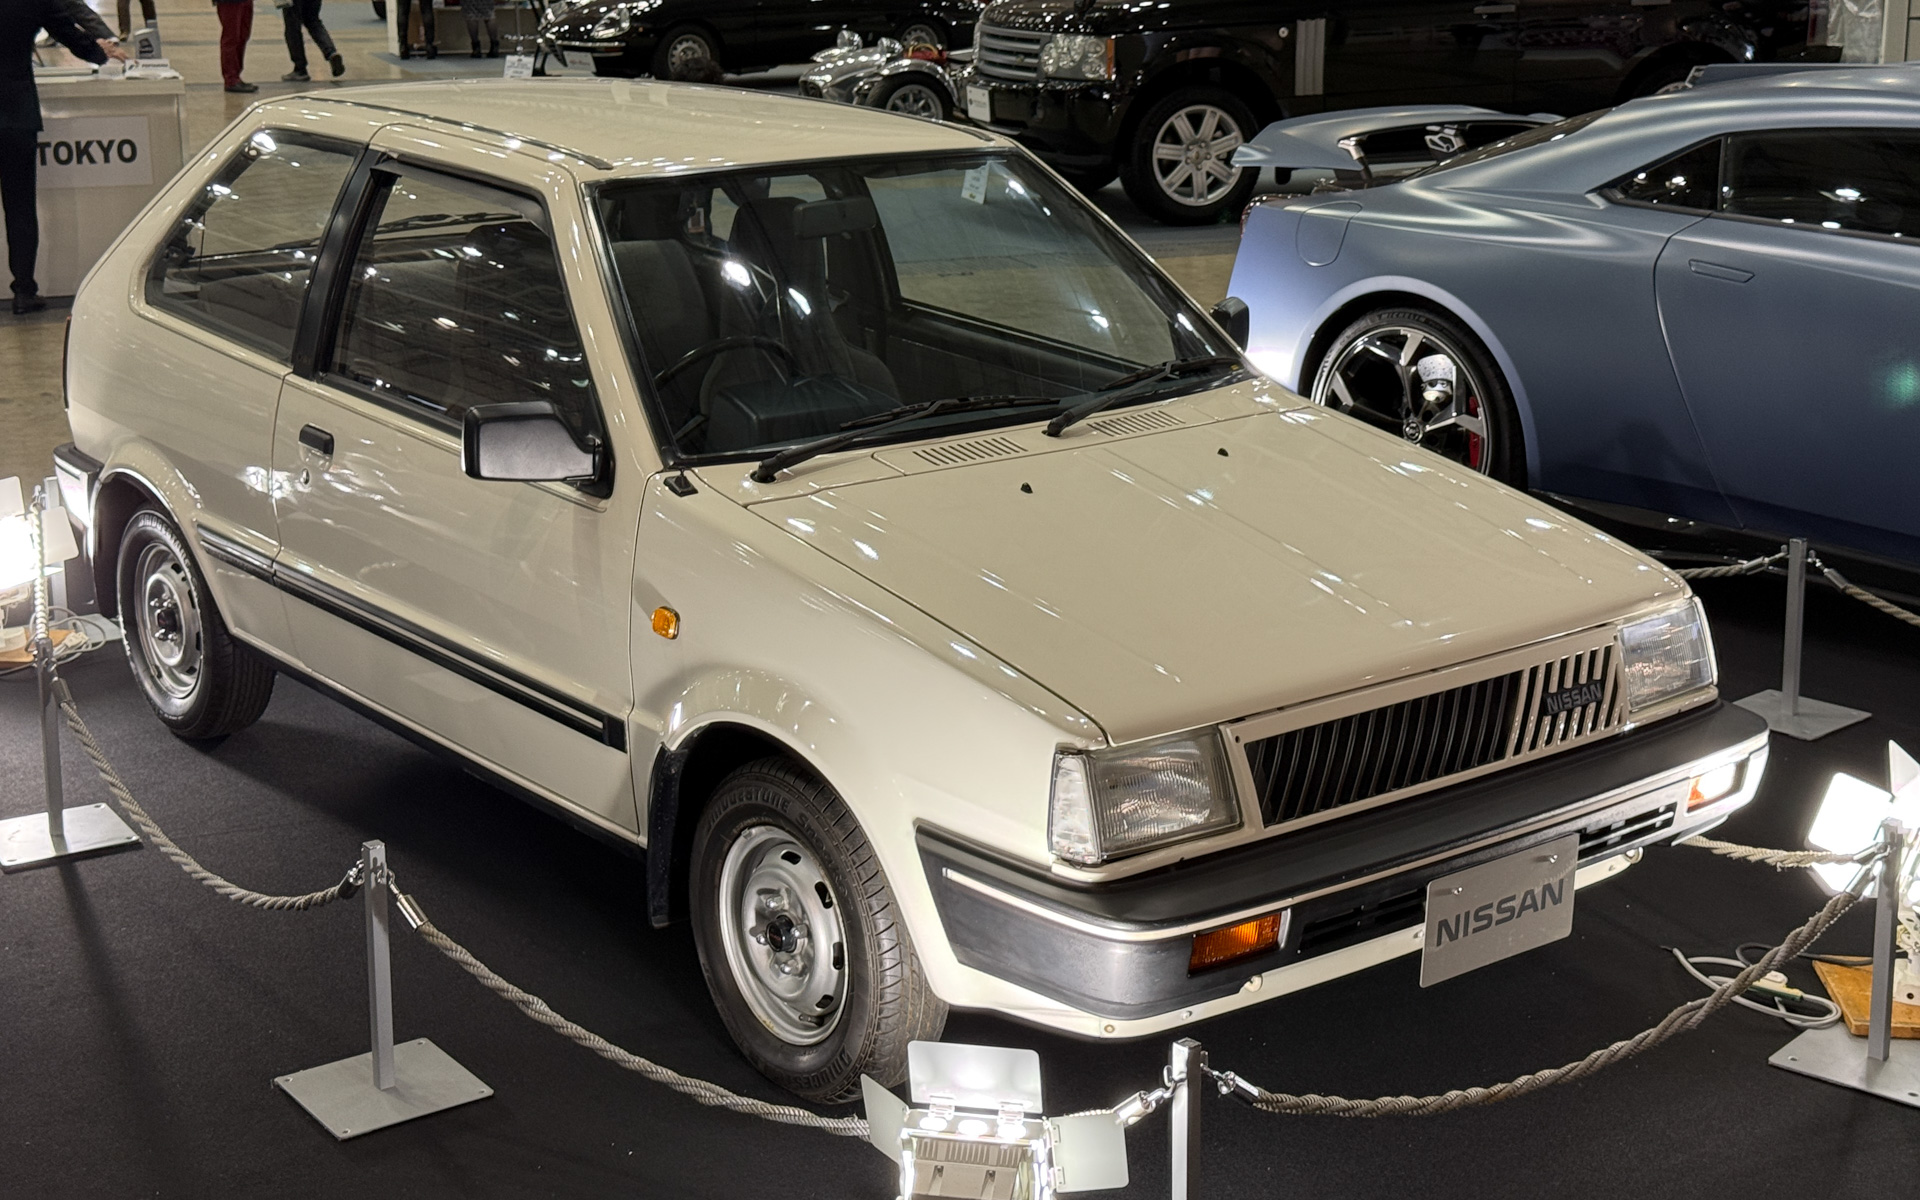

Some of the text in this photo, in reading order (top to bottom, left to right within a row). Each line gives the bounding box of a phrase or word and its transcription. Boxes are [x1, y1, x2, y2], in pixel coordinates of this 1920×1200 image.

[38, 138, 138, 166] TOKYO
[1547, 683, 1603, 714] NISSAN
[1436, 878, 1565, 948] NISSAN
